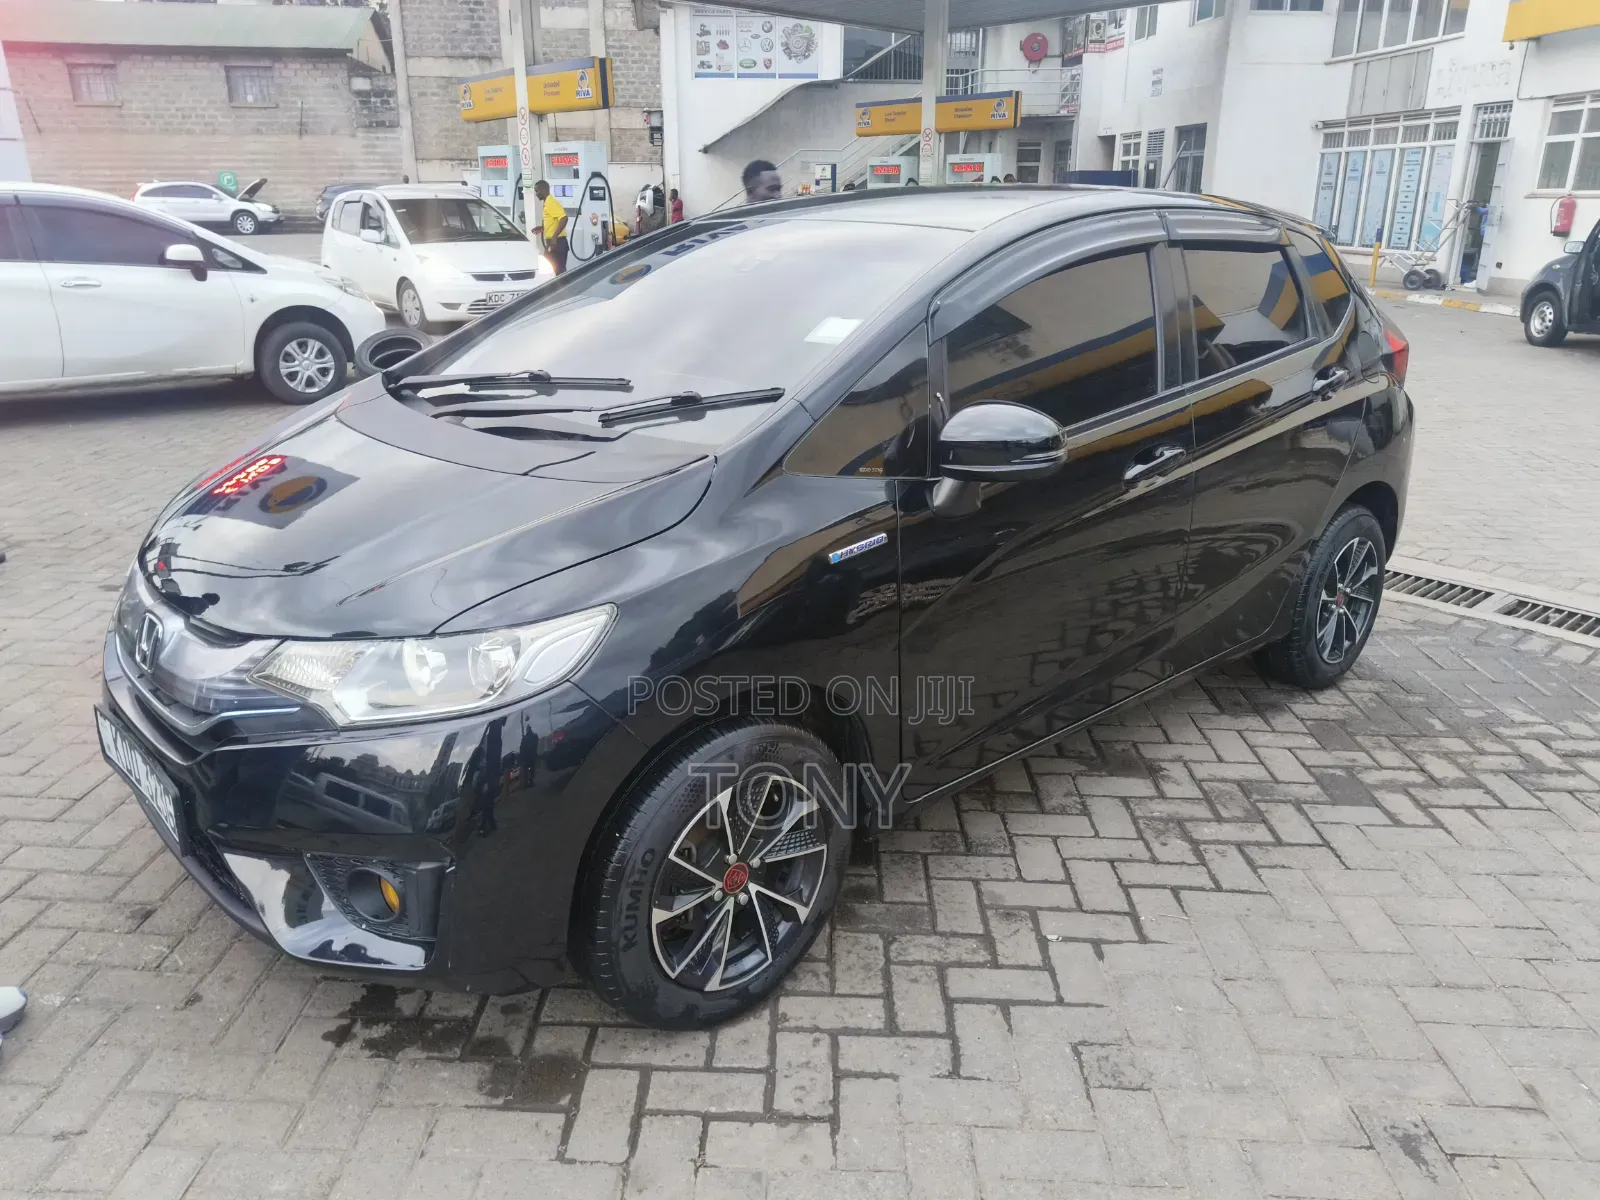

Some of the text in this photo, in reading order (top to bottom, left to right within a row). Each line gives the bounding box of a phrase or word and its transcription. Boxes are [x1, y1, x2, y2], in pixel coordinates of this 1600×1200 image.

[576, 89, 591, 97] RIVA
[488, 294, 505, 303] KDC
[840, 535, 884, 559] HYBRID
[621, 847, 656, 953] KUMHO
